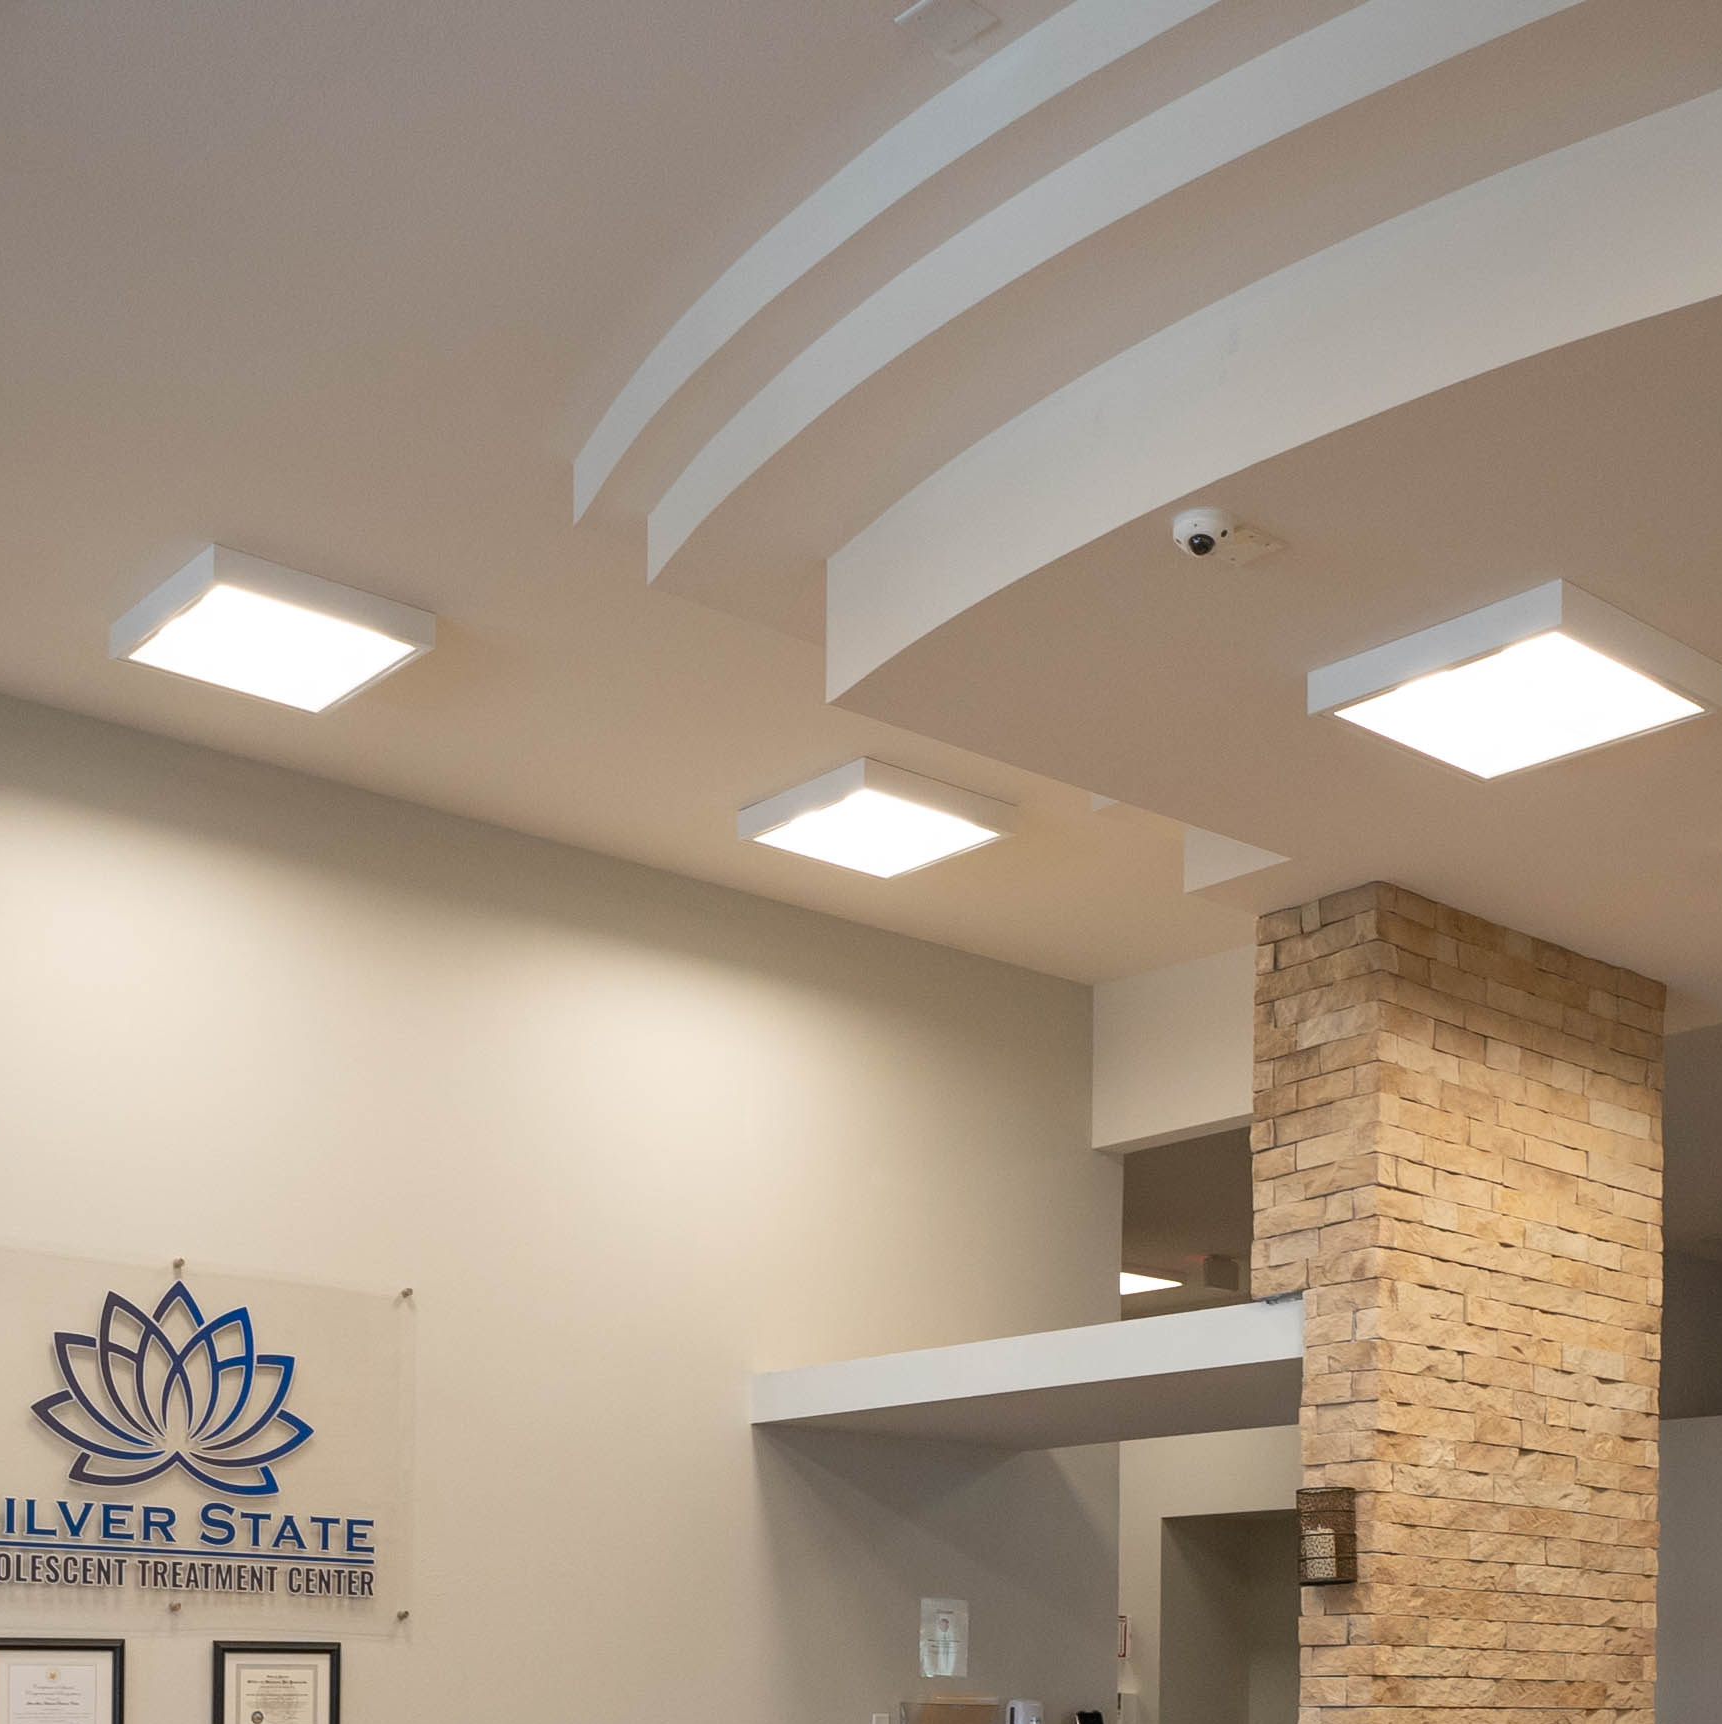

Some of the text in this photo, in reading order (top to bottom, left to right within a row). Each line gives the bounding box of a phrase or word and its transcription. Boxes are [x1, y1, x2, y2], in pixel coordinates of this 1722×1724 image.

[199, 1502, 375, 1554] STATE
[137, 1559, 278, 1593] TREATMENT
[288, 1567, 374, 1596] CENTER
